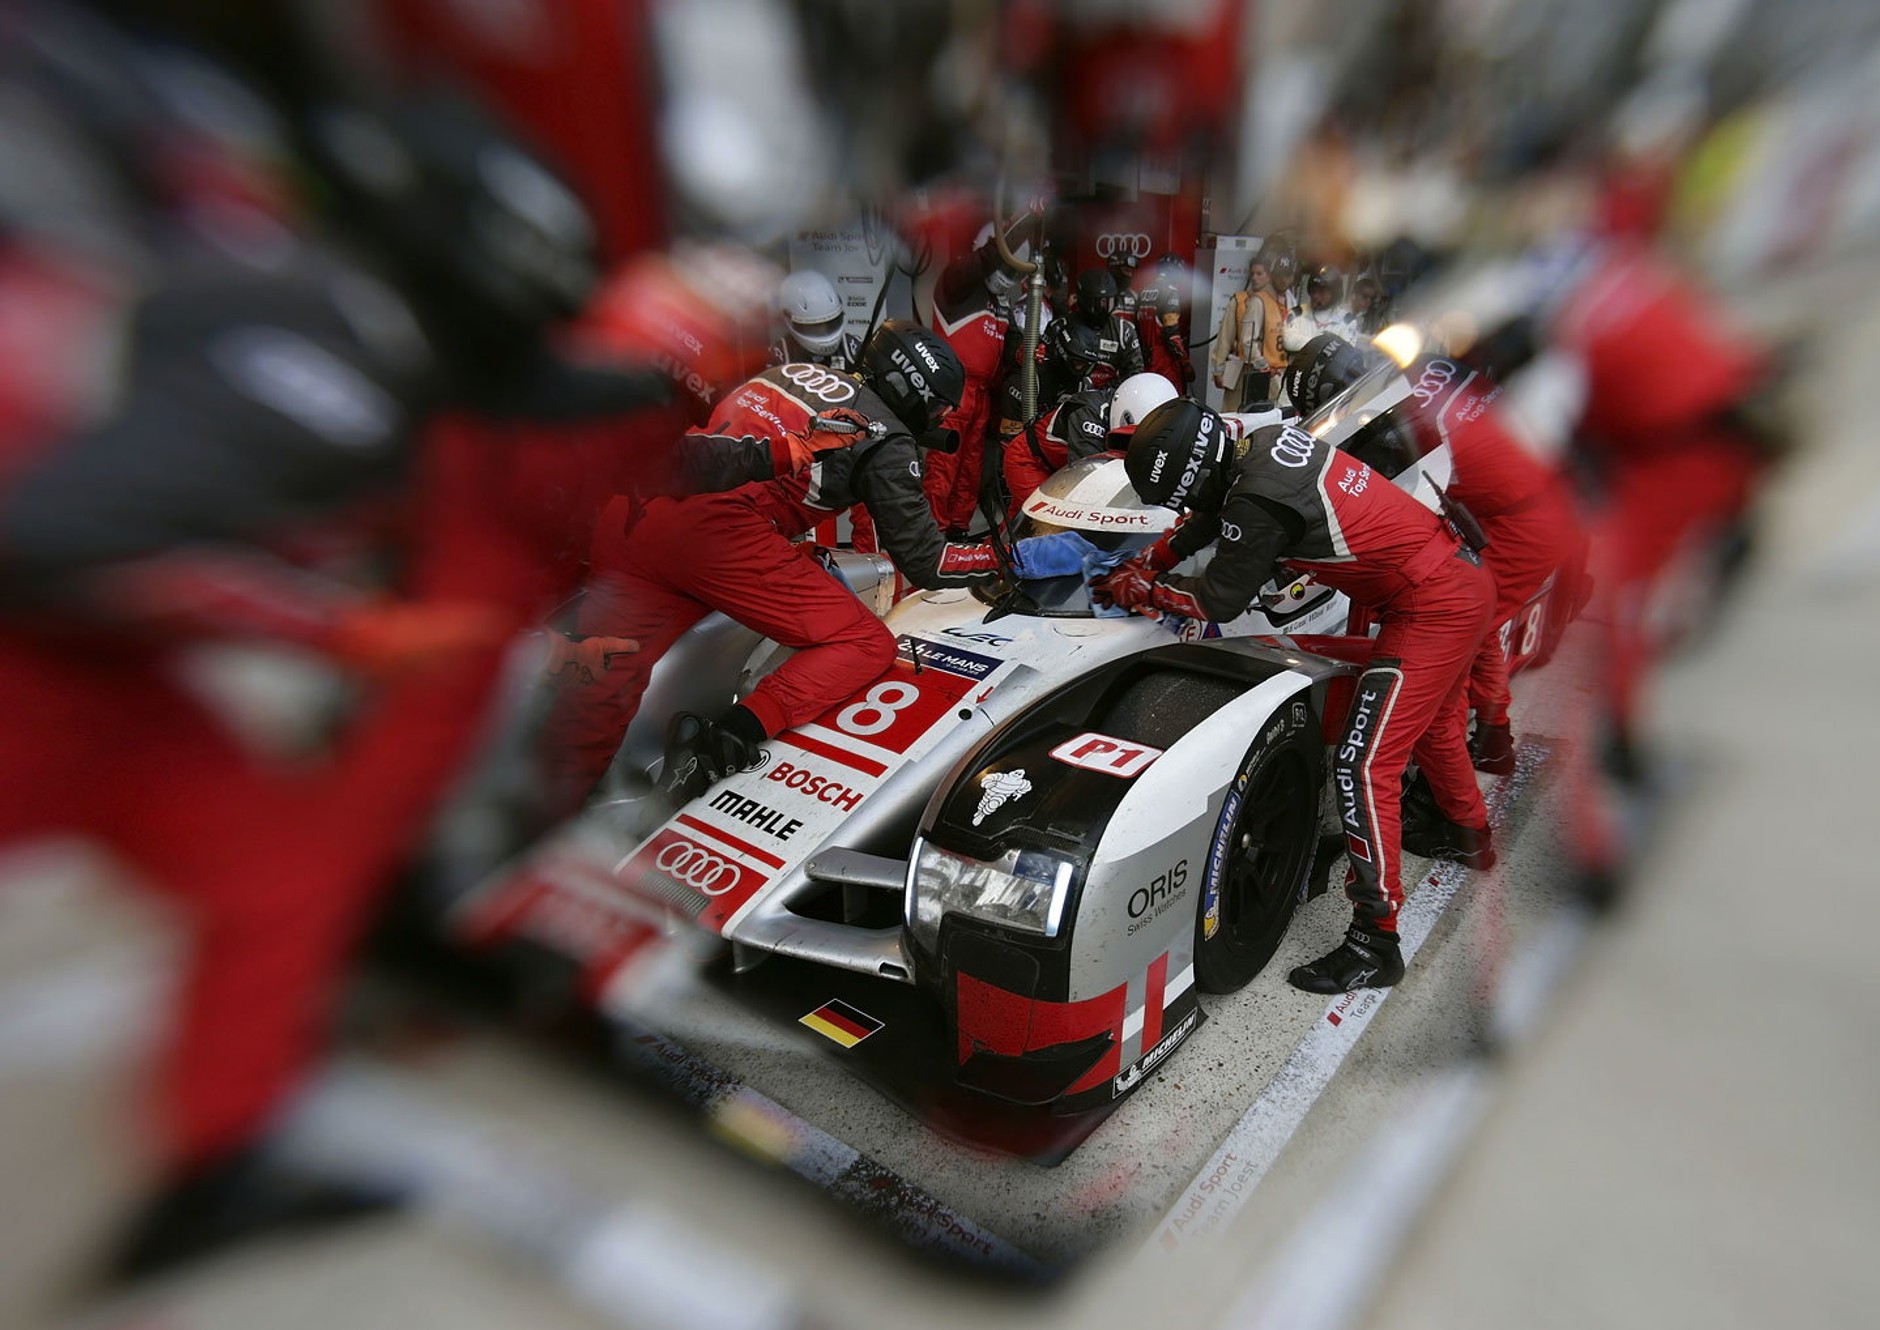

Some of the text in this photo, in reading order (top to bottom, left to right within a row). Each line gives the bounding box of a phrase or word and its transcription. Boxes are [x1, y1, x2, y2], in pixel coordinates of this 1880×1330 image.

[891, 348, 936, 404] uvex
[914, 341, 940, 373] uvex
[1293, 369, 1303, 397] uvex
[1455, 395, 1478, 422] Audi
[1149, 450, 1169, 484] uvex
[1166, 456, 1202, 508] uvex
[1348, 478, 1368, 497] Top
[1043, 505, 1149, 525] Audi Sport
[941, 627, 1014, 646] WEC
[1520, 602, 1542, 656] 8
[923, 650, 944, 660] LE
[942, 655, 989, 673] MANS
[836, 680, 920, 736] 8
[1069, 739, 1145, 768] P1
[1336, 690, 1377, 828] Audi Sport
[767, 752, 865, 812] BOSCH
[708, 789, 804, 841] MAHLE
[1209, 797, 1238, 895] MICHELIN
[1127, 859, 1188, 919] ORIS
[1127, 913, 1154, 937] Swiss
[1350, 992, 1377, 1019] Team
[1141, 1013, 1196, 1069] MICHELIN
[1174, 1152, 1238, 1232] Audi Sport
[1222, 1159, 1260, 1201] Joest
[936, 1212, 994, 1256] Sport
